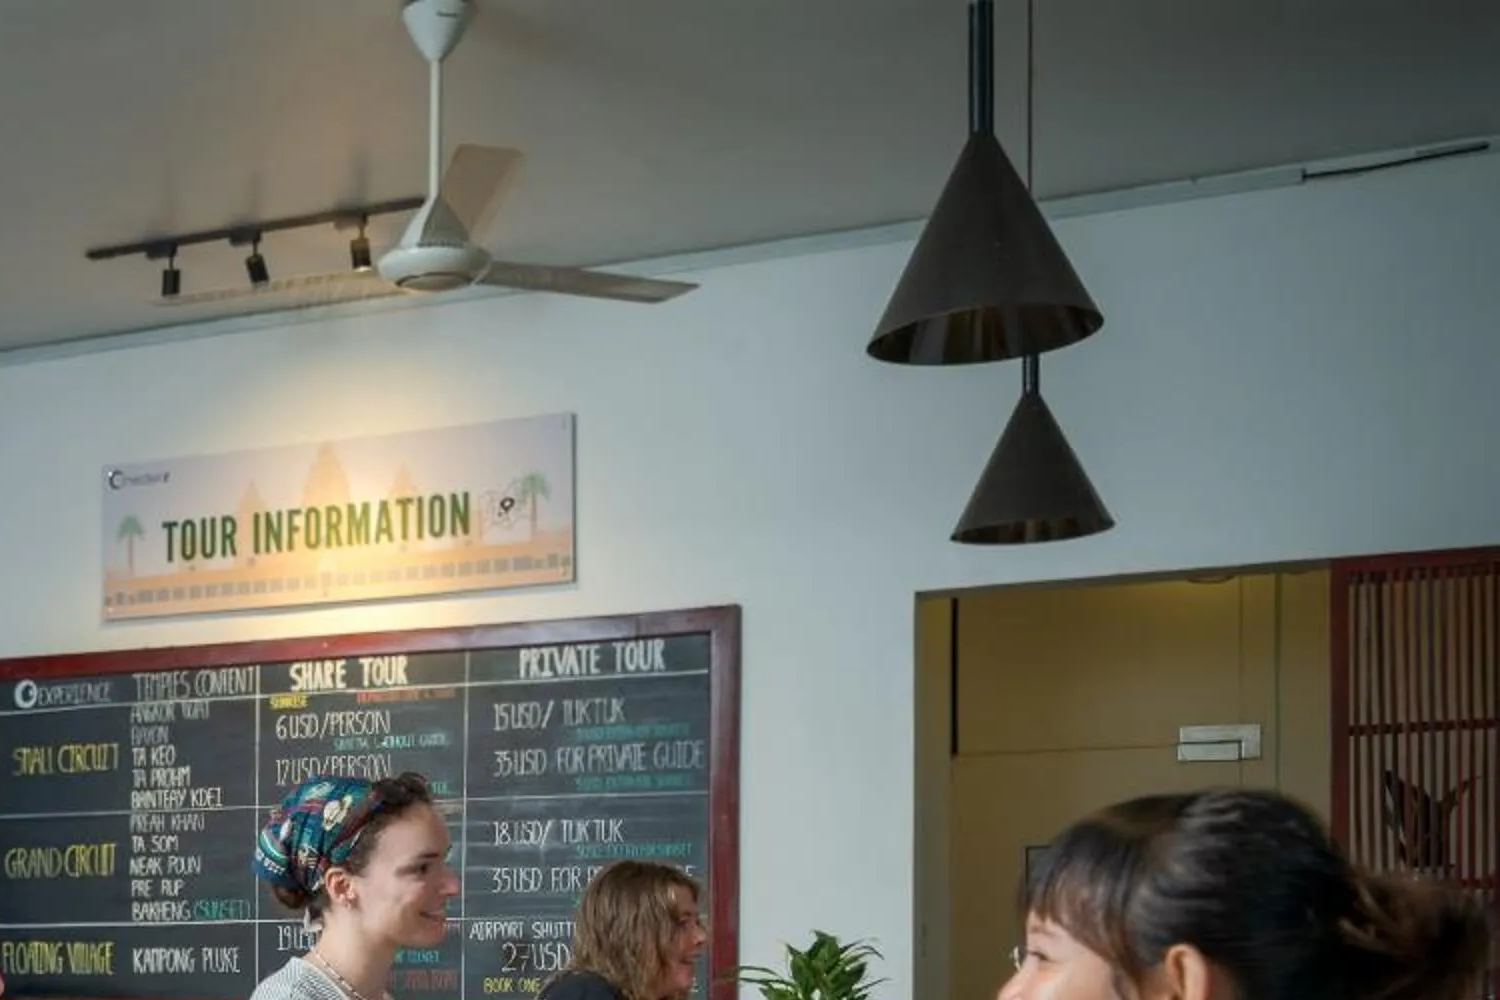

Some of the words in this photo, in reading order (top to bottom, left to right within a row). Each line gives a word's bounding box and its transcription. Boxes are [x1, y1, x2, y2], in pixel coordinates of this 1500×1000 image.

[162, 514, 237, 563] TOUR
[253, 492, 470, 555] INFORMATION
[289, 659, 347, 691] SHARE
[359, 655, 409, 687] TOUR
[519, 644, 600, 680] PRIVATE
[612, 638, 666, 672] TOUR
[132, 669, 191, 700] TEMPLES
[195, 666, 254, 696] CONTENT
[57, 743, 119, 774] CIRCUIT
[132, 747, 147, 767] TA
[151, 744, 176, 767] KEO
[588, 743, 647, 773] PRIVATE
[653, 739, 705, 769] GUIDE
[150, 765, 191, 788] PROHM
[132, 836, 145, 852] TA
[151, 835, 179, 852] SOM
[4, 848, 63, 879] GRAND
[64, 842, 117, 878] CIRCUIT
[129, 857, 162, 876] NEAK
[131, 880, 151, 898] PRE
[160, 879, 185, 897] RUP
[551, 865, 581, 893] FOR
[469, 921, 525, 941] AIRPORT
[532, 921, 578, 939] SHUTT
[483, 977, 514, 994] BOOK
